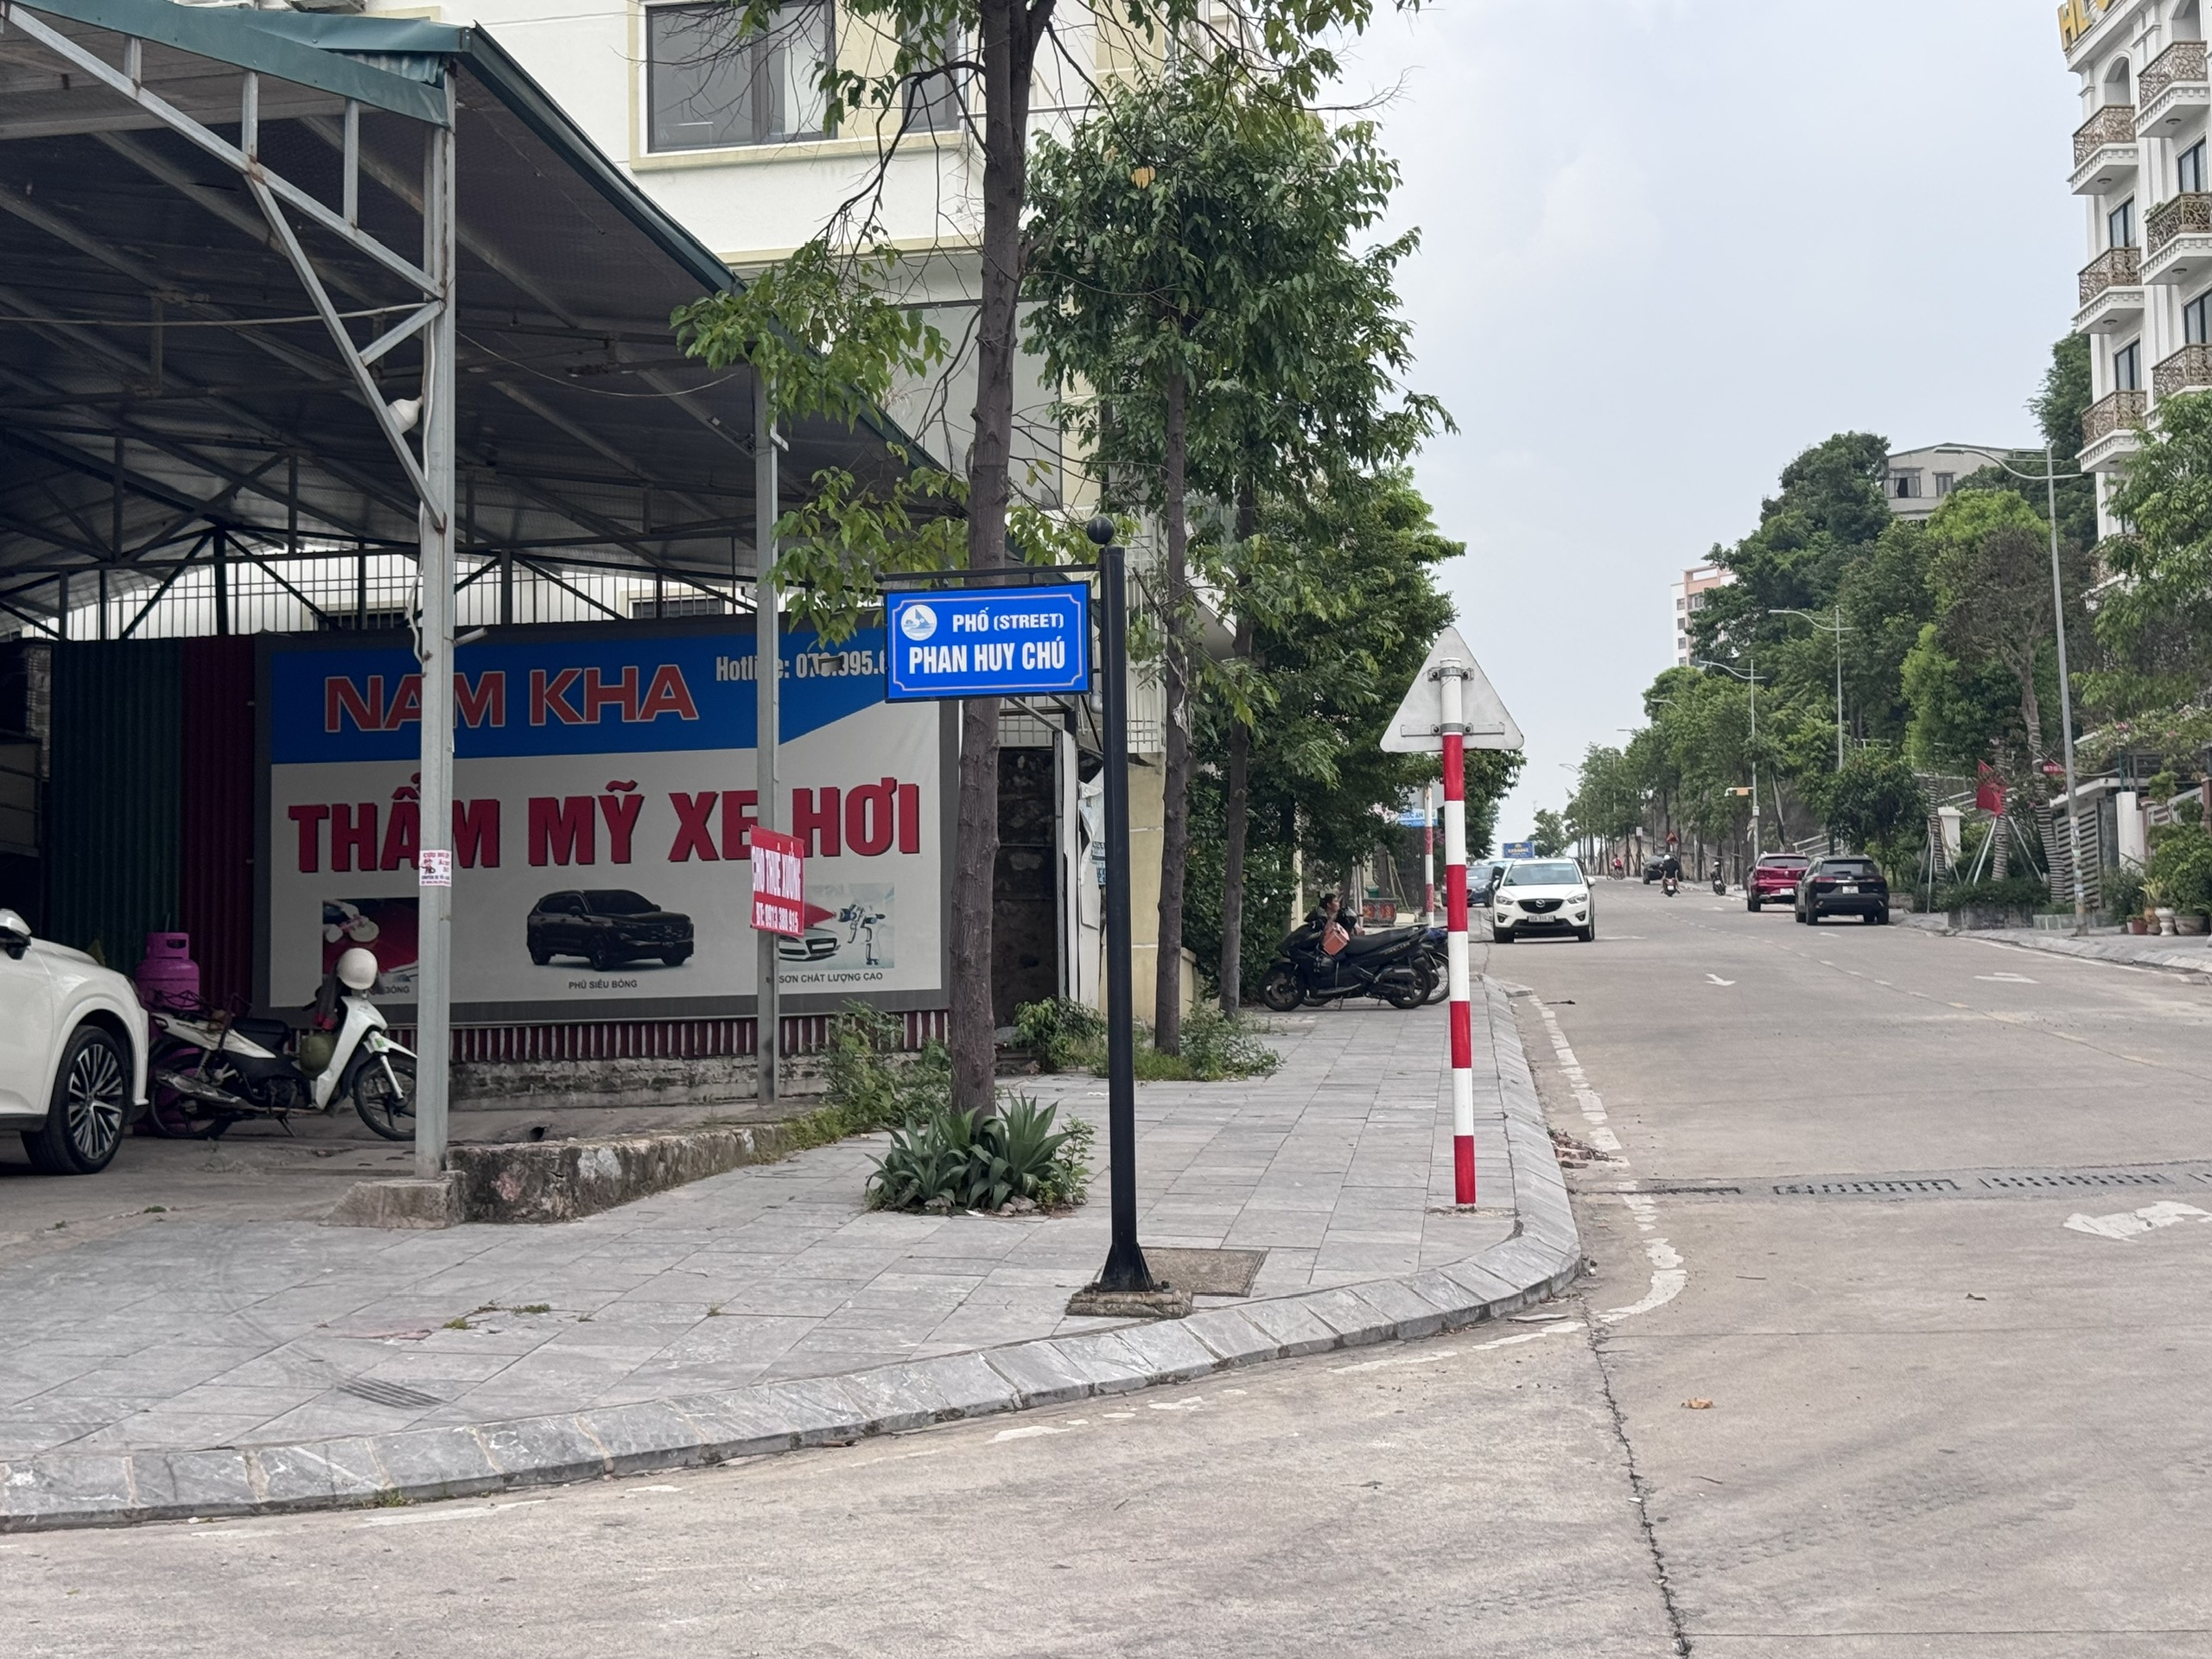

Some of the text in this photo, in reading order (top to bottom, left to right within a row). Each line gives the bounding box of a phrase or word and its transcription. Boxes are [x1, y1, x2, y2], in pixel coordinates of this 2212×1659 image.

[952, 607, 1065, 632] PHỐ (STREET)
[715, 655, 790, 681] Hotlie:
[909, 636, 1065, 674] PHAN HUY CHÚ
[325, 664, 700, 733] NAM KHA
[528, 780, 645, 867] MỸ
[667, 789, 758, 861] XE
[792, 777, 920, 858] HƠI
[779, 974, 799, 984] SƠN
[827, 972, 861, 984] LƯỢNG
[862, 971, 883, 982] CAO
